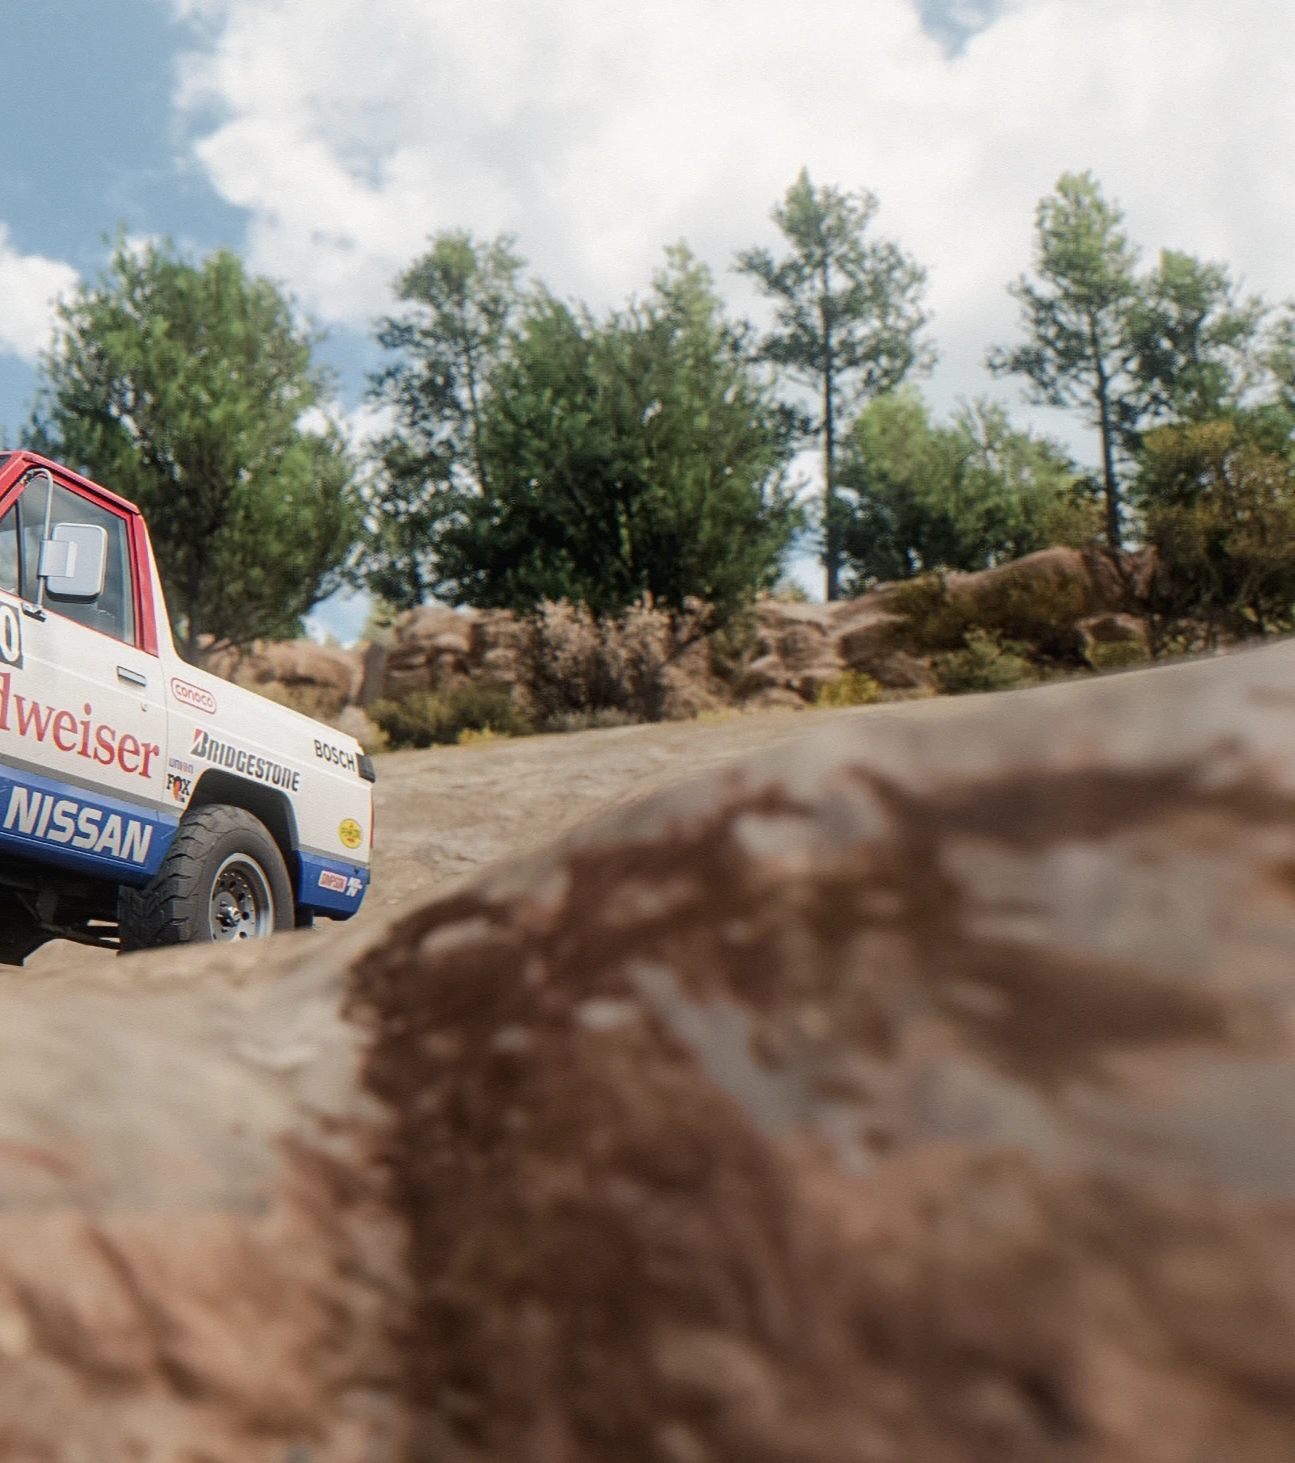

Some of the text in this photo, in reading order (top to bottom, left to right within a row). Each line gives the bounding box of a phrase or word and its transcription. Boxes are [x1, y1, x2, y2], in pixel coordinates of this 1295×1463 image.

[190, 728, 301, 792] BRIDGESTONE
[313, 739, 356, 772] BOSCH
[3, 786, 153, 863] NISSAN
